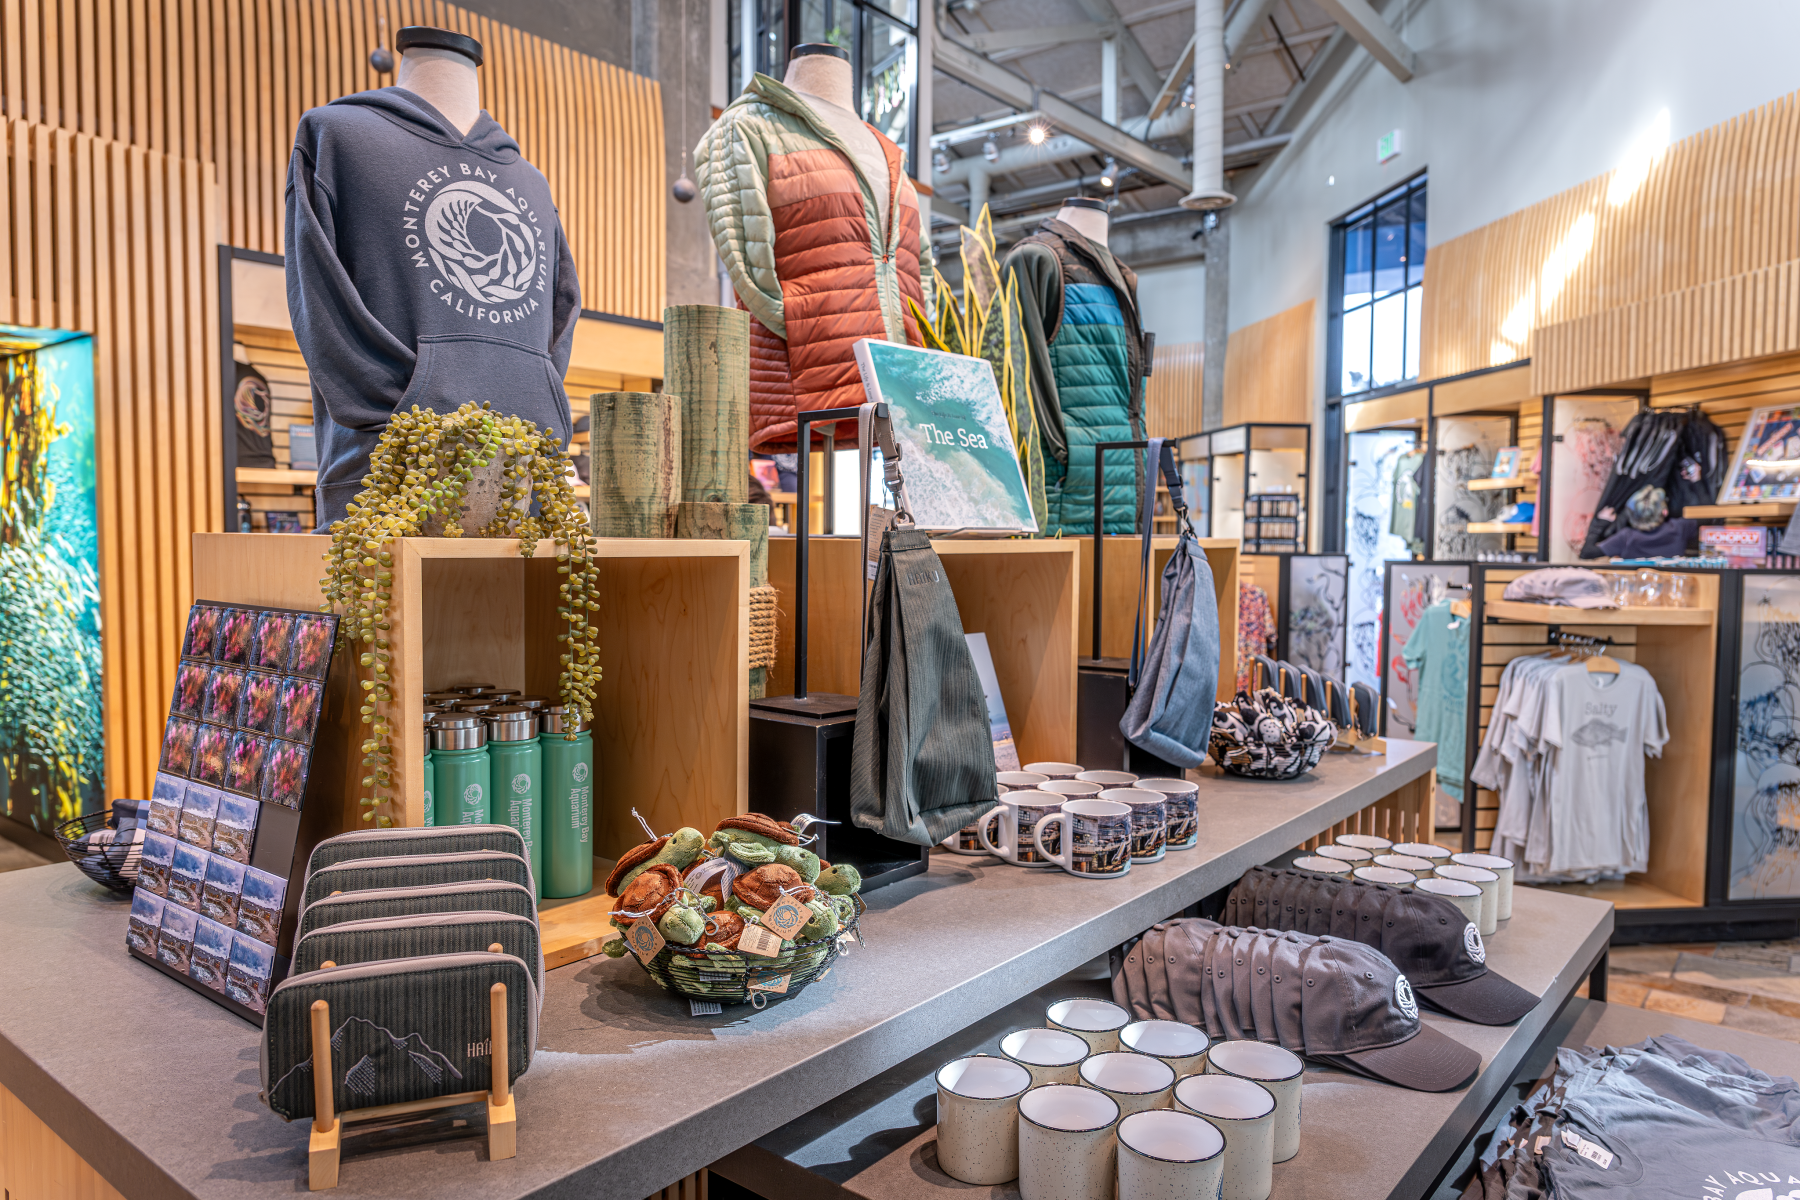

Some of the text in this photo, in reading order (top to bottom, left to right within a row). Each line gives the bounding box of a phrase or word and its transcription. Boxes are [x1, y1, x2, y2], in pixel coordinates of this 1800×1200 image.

[403, 163, 547, 293] MONTEREY BAY AQUARIUM
[430, 279, 539, 323] CALIFORNIA
[919, 423, 988, 449] The Sea
[1706, 531, 1759, 544] MONOPOLY
[1585, 702, 1618, 718] Salty
[508, 800, 522, 829] Aquari
[522, 798, 532, 840] Monterey
[569, 788, 581, 829] Aquarium
[580, 786, 590, 842] Monterey Bay
